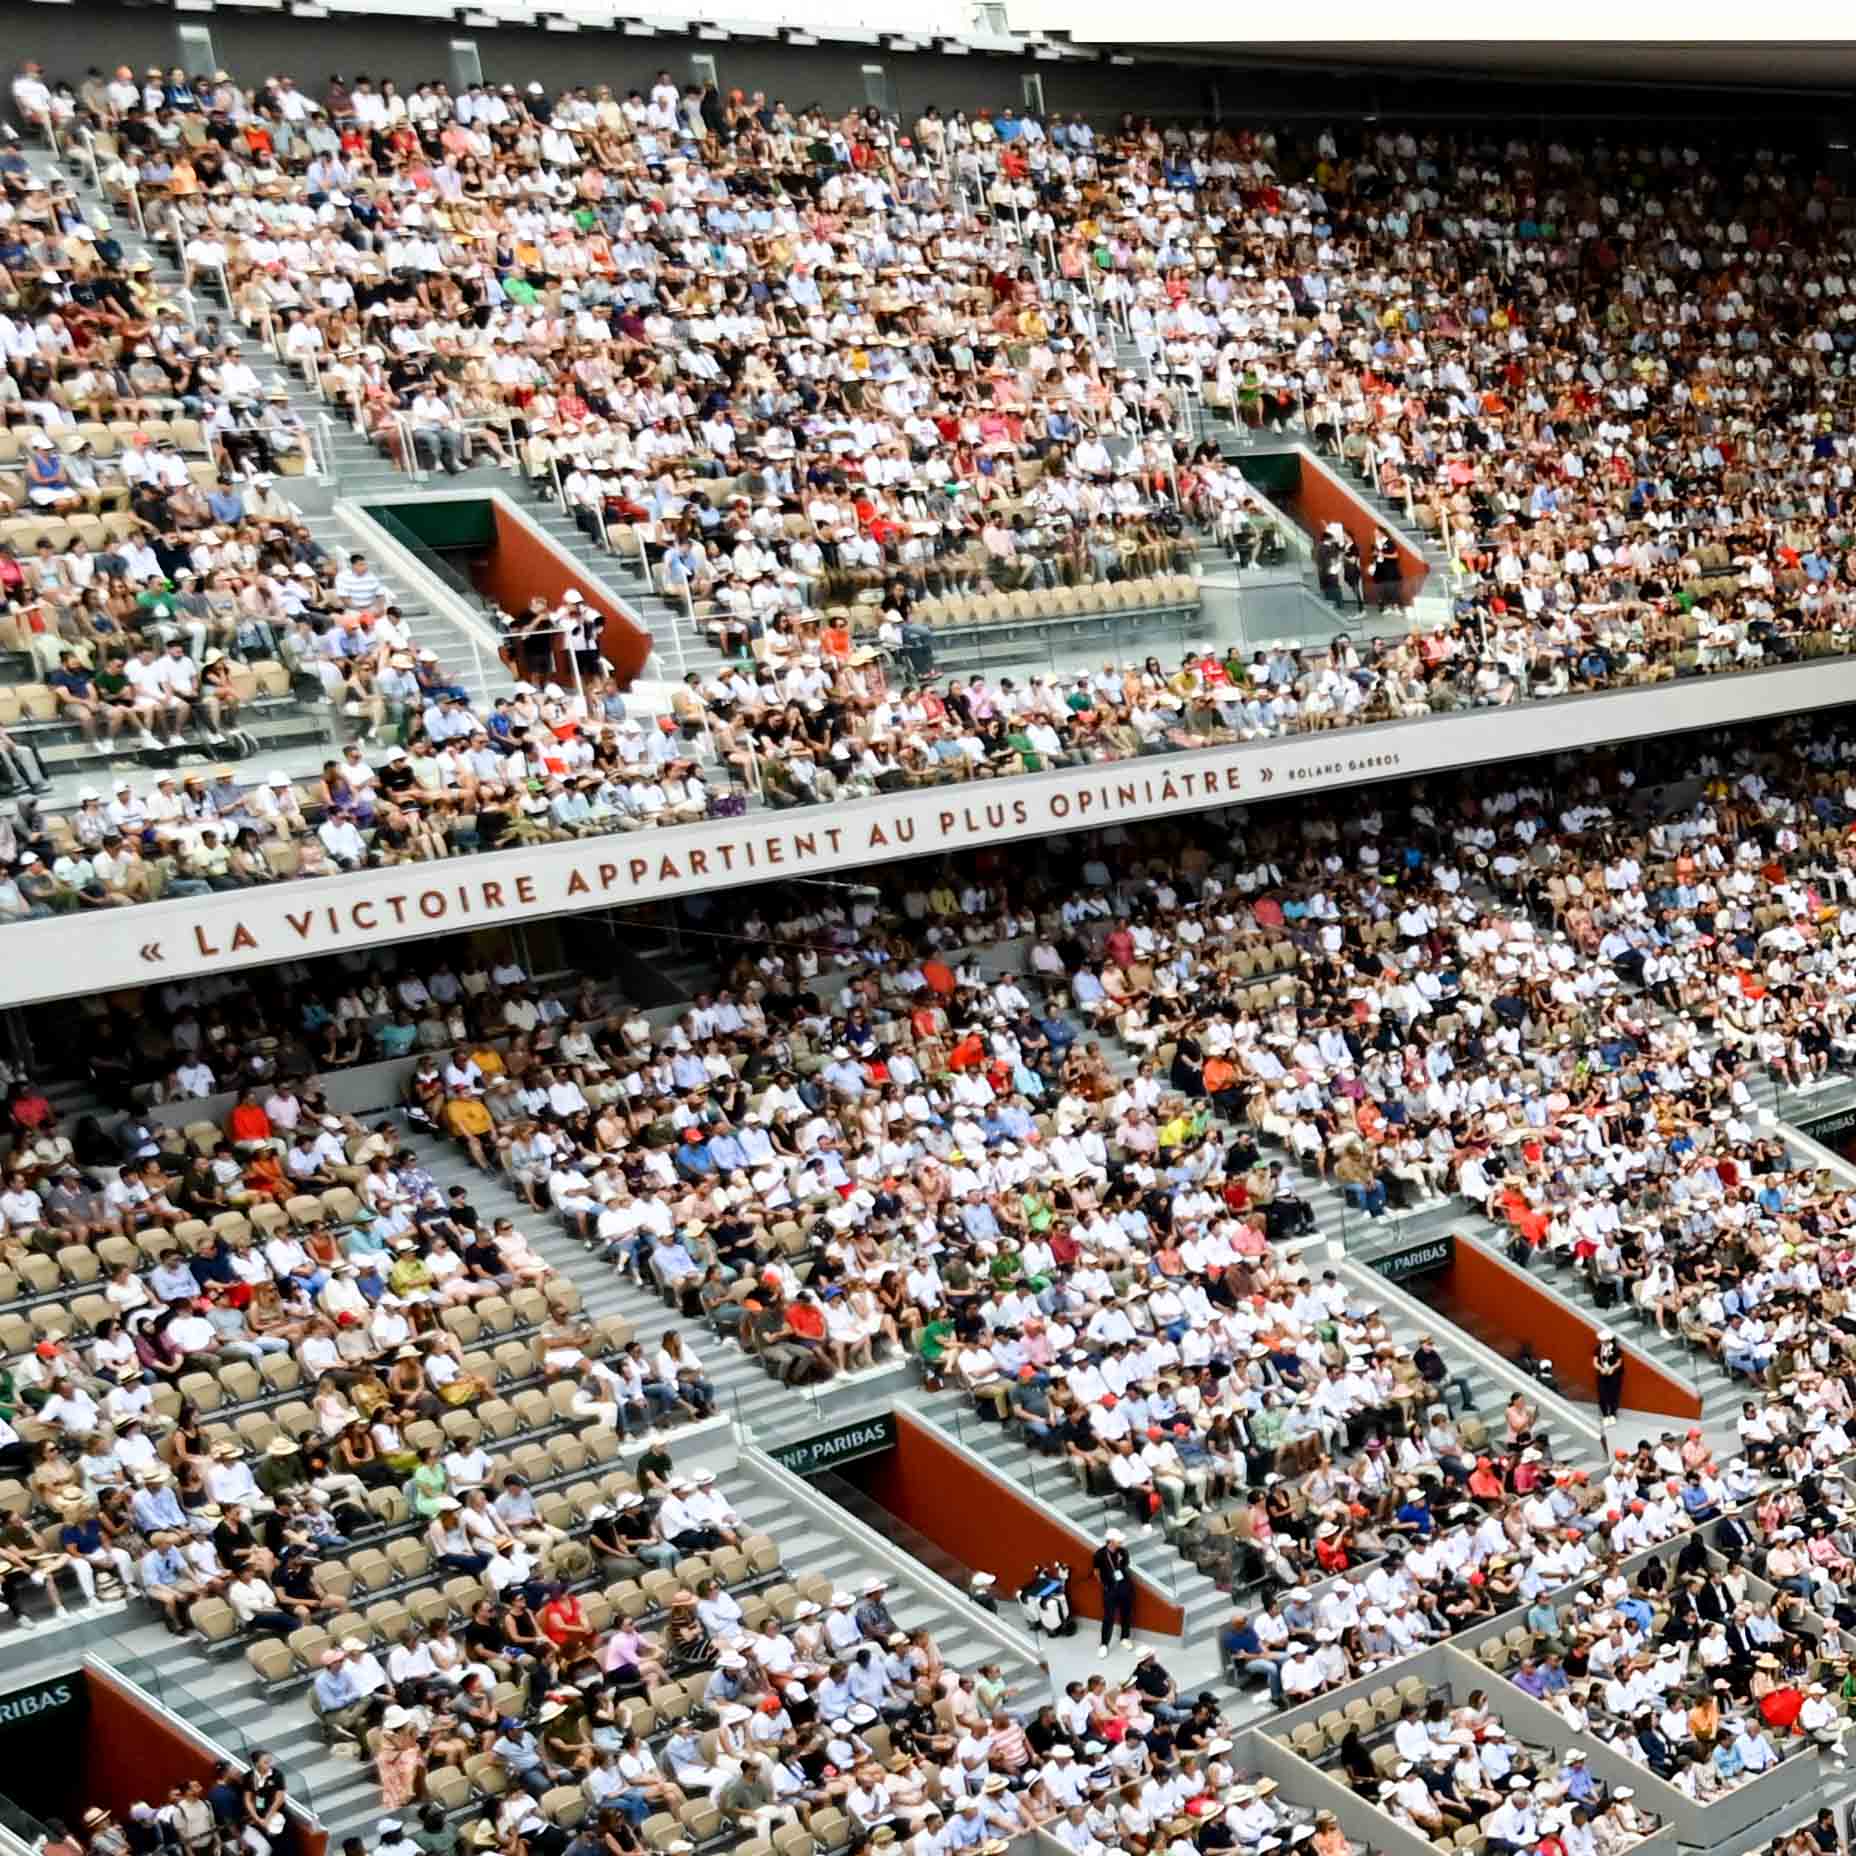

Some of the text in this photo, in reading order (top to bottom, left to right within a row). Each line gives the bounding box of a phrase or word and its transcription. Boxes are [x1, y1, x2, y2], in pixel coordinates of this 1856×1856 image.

[1288, 753, 1402, 781] ROLAND GARROS
[193, 921, 258, 958] LA
[286, 875, 538, 940] VICTOIRE
[565, 828, 844, 897] APPARTIENT
[868, 817, 914, 848] AU
[940, 800, 1028, 836] PLUS
[1049, 769, 1241, 820] OPINIÂTRE
[1395, 1244, 1447, 1270] PARIBAS
[812, 1424, 886, 1458] PARIBAS
